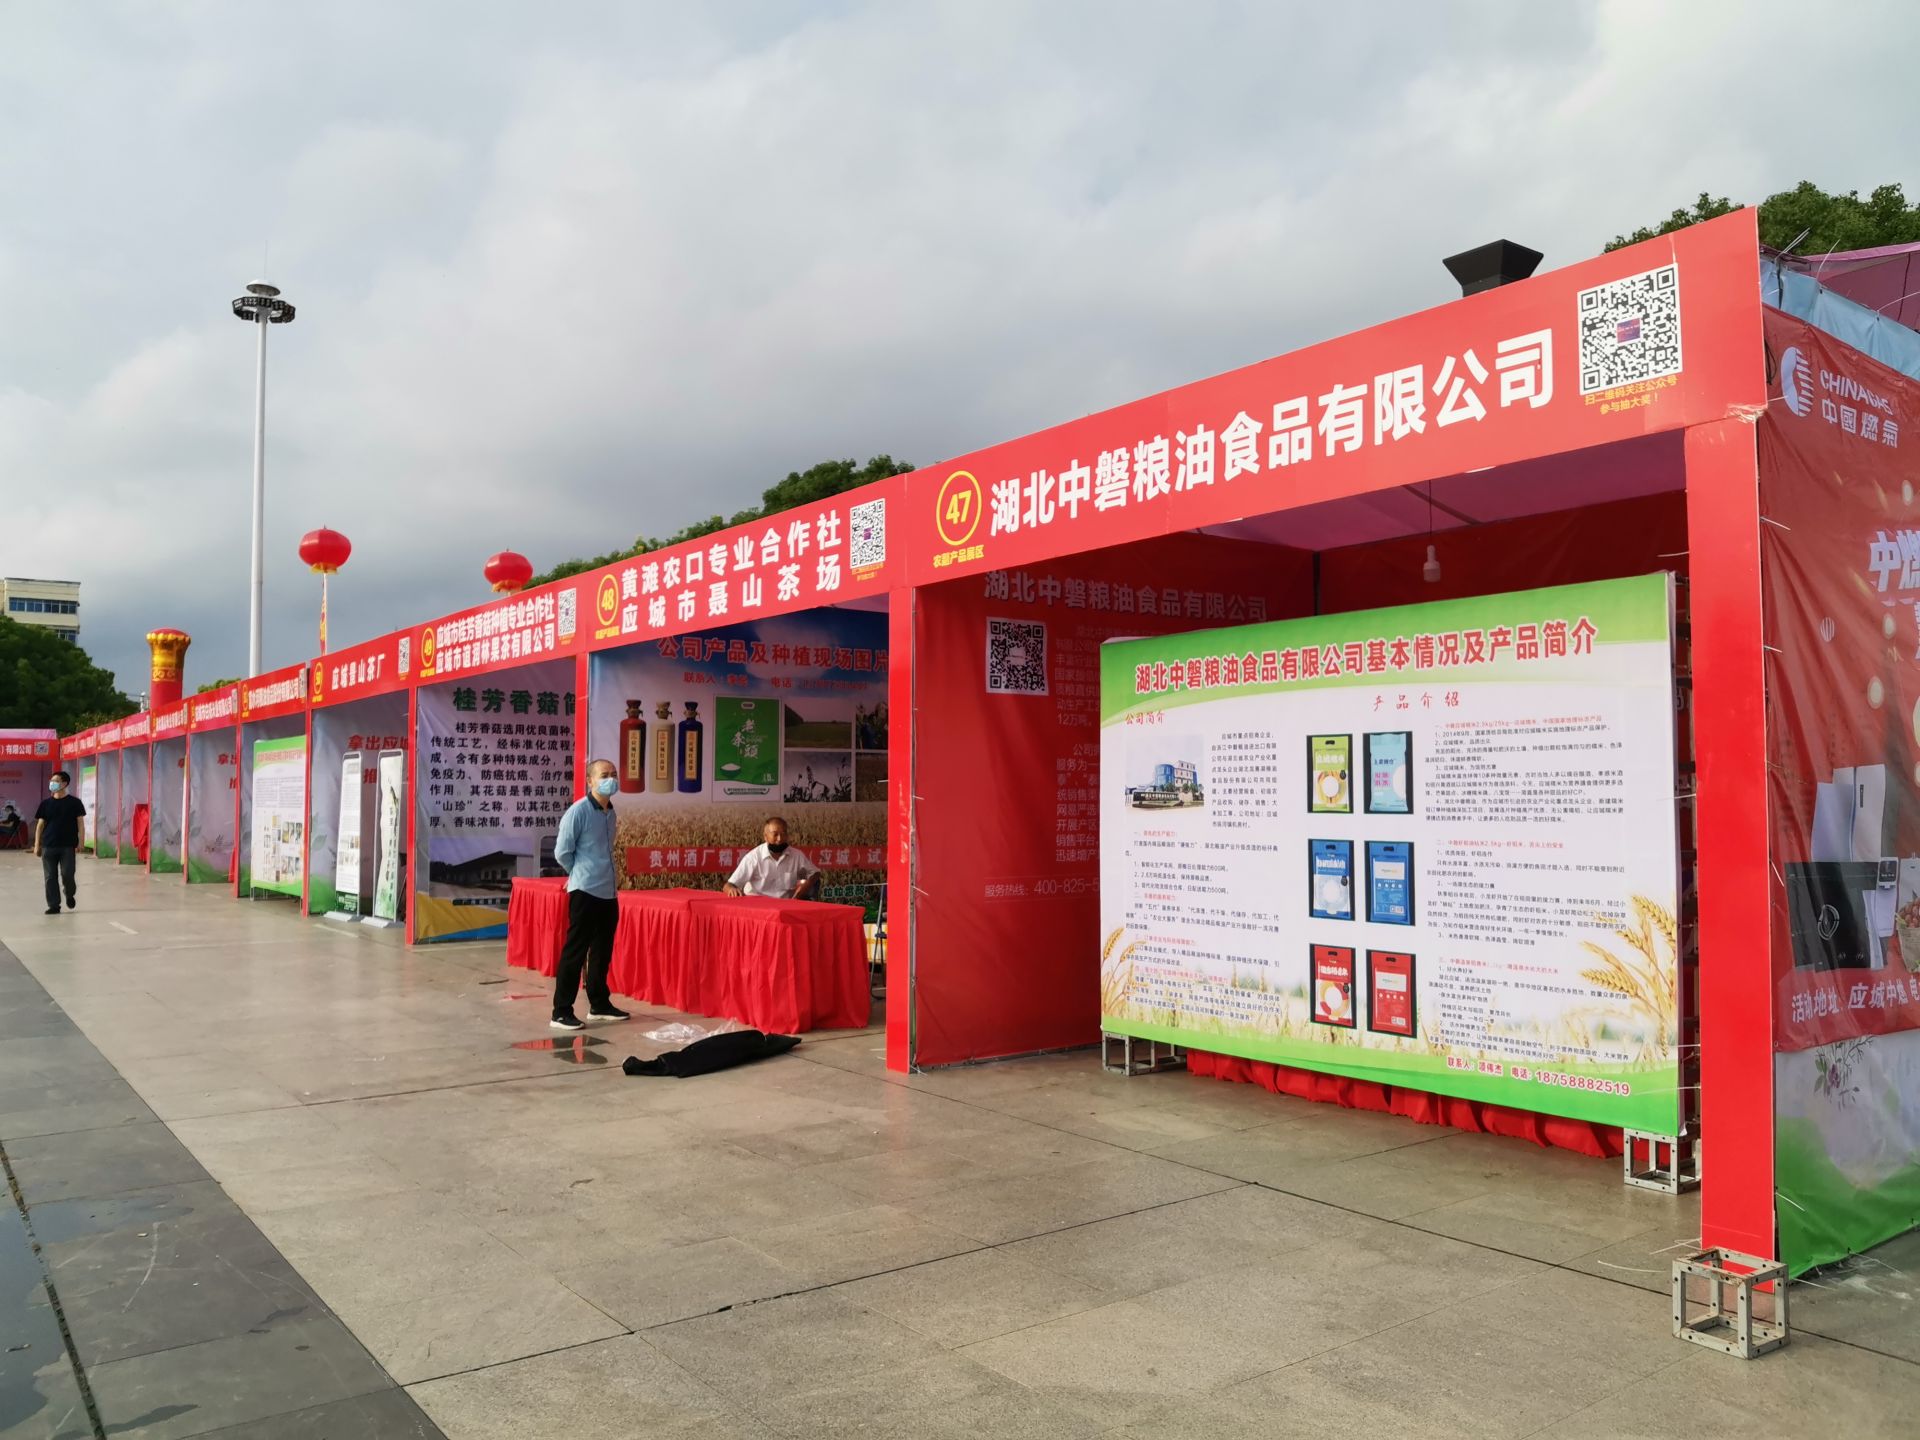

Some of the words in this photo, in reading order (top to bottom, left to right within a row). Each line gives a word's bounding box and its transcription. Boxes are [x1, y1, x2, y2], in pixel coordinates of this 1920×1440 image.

[1584, 374, 1679, 406] 扫二维码关注公众号
[990, 329, 1553, 537] 湖北中磐粮油食品有限公司
[945, 490, 972, 524] 47
[621, 511, 841, 601] 黄滩农口专业合作社
[602, 588, 614, 611] 48
[621, 554, 841, 633] 应城市聂山茶场
[1135, 617, 1598, 695] 湖北中磐粮油食品有限公司基本情况及产品简介
[1125, 710, 1165, 725] 公司简介
[1373, 691, 1460, 712] 产品介绍
[1536, 1071, 1631, 1097] 18758882519
